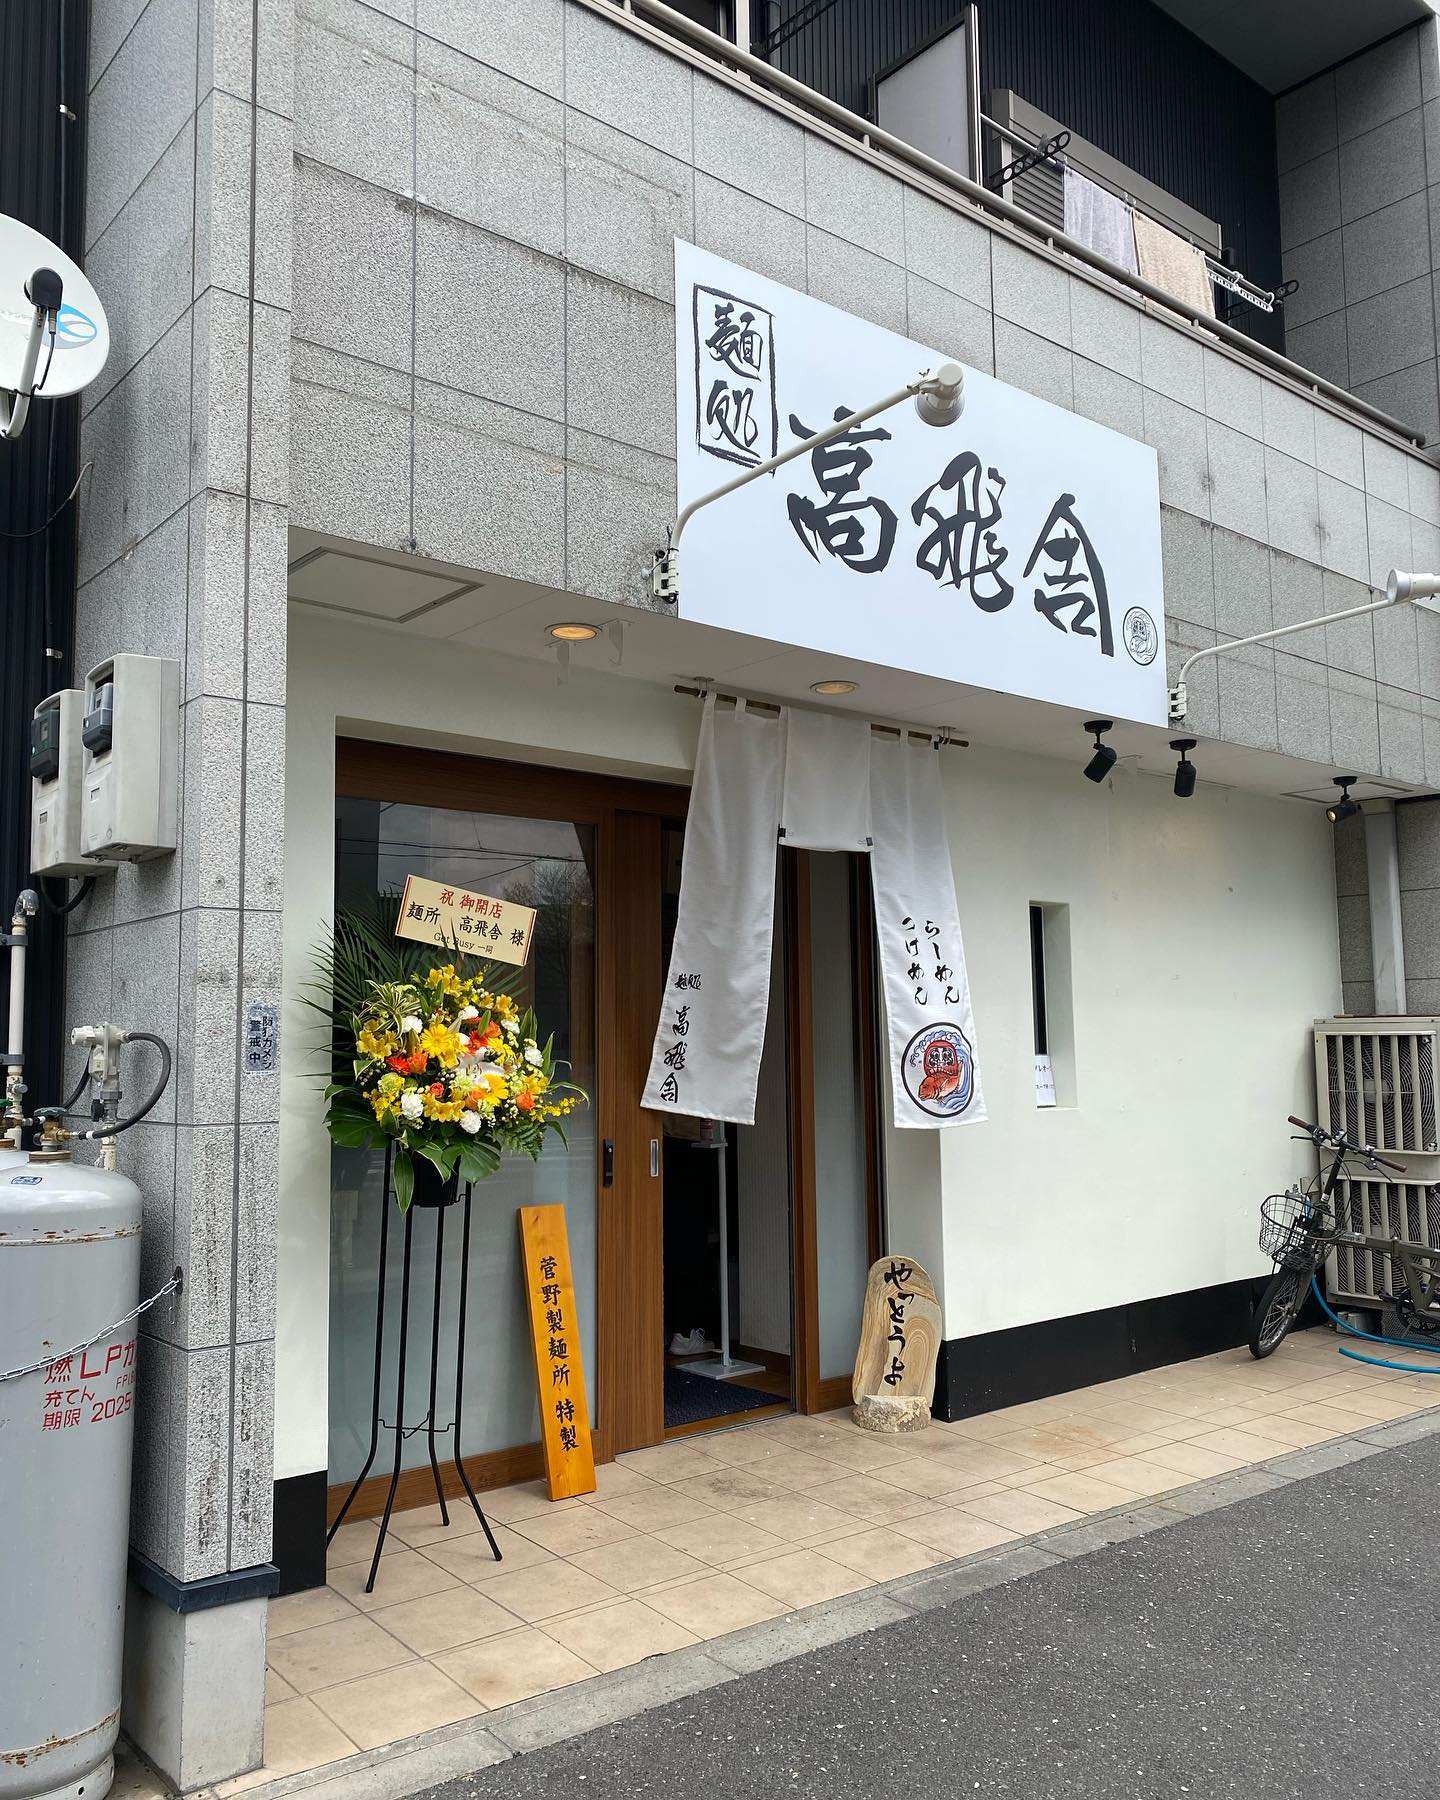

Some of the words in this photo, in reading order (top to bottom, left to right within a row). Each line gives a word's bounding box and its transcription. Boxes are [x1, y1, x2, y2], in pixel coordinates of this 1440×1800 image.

[439, 888, 454, 907] 祝
[459, 894, 503, 919] 御開店
[510, 928, 526, 947] 様
[902, 916, 929, 1006] つけめん
[924, 919, 960, 1005] らーめん
[43, 1385, 95, 1409] 充てん
[42, 1408, 81, 1431] 期限
[555, 1397, 579, 1452] 特製
